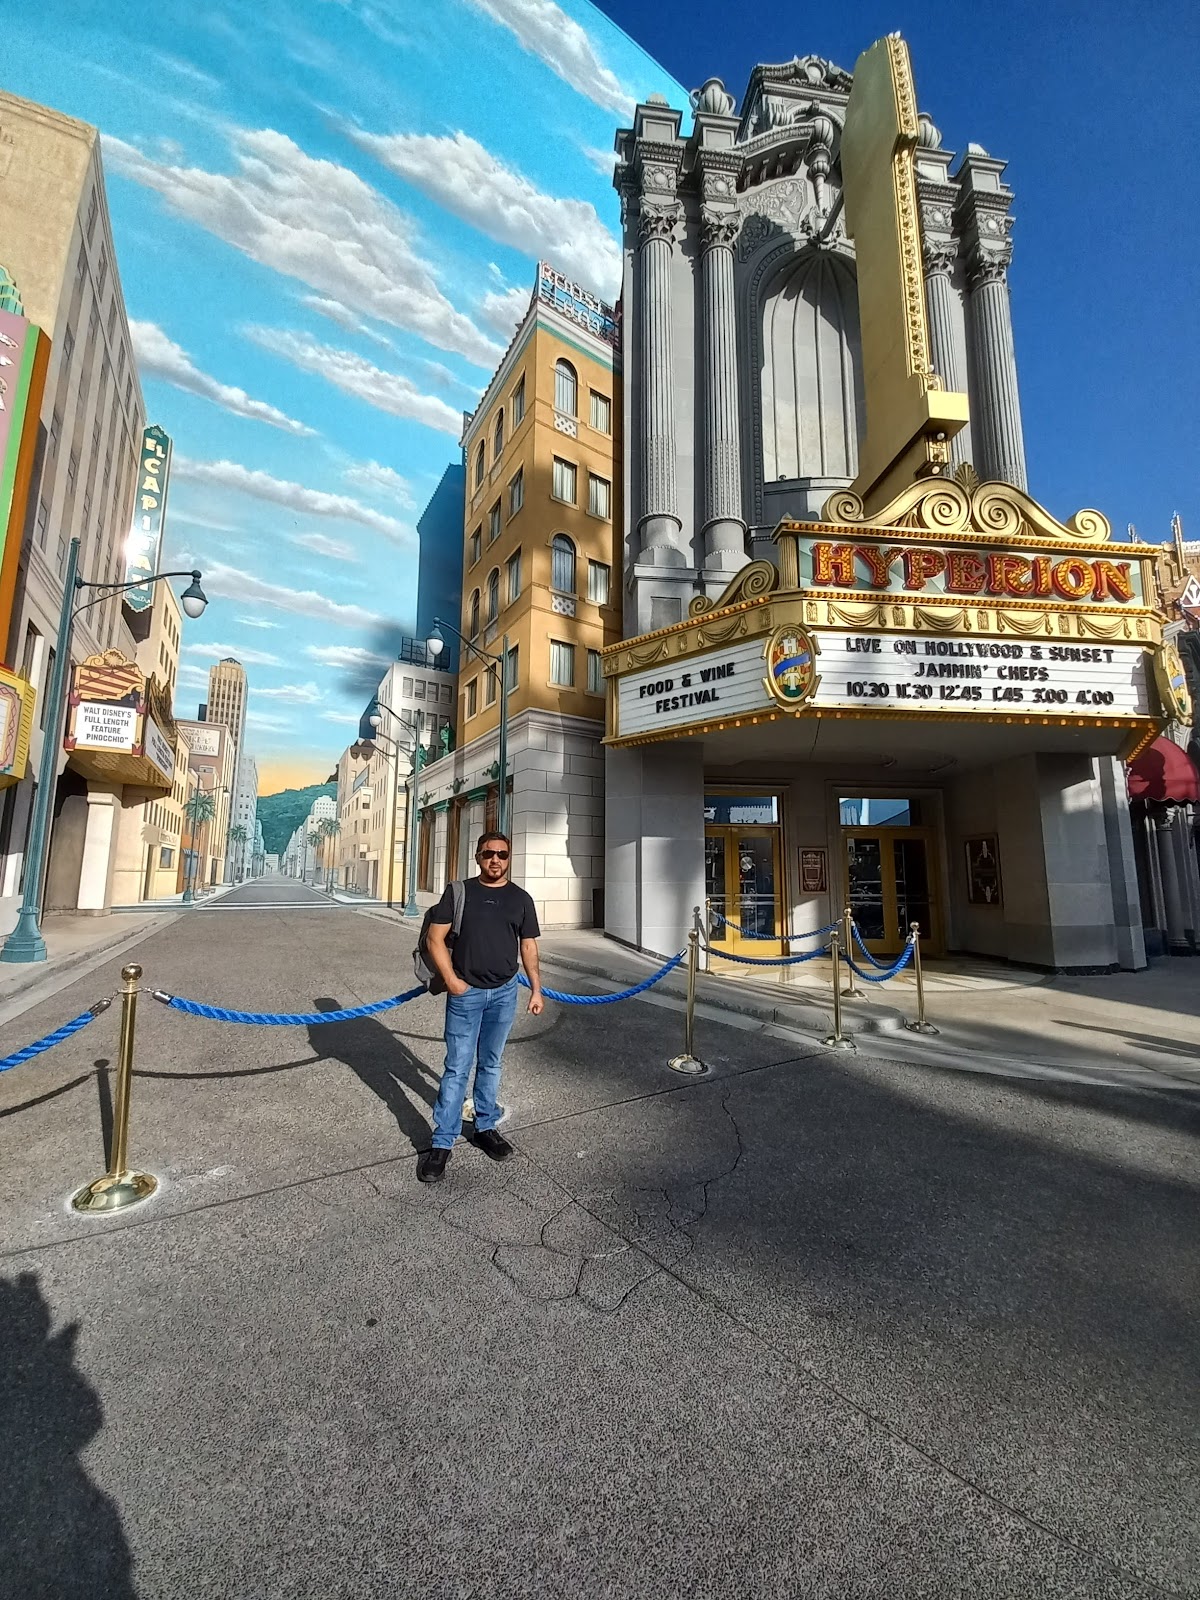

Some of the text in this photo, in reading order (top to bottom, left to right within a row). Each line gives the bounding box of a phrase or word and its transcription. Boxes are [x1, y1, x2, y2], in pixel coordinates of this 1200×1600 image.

[145, 437, 166, 459] EL
[811, 542, 1136, 603] HYPERION
[846, 638, 1114, 663] LIVE ON HOLLYWOOD & SUNSET
[639, 662, 735, 698] FOOD & WINE
[914, 662, 1050, 682] JAMMIN' CHEFS
[656, 688, 720, 713] FESTIVAL
[846, 681, 890, 698] 10:30
[896, 683, 933, 699] 11:30
[939, 684, 982, 701] 12:45
[1031, 688, 1068, 704] 3:00
[1075, 690, 1114, 706] 4:00
[84, 706, 132, 718] WALT DISNEY'S
[84, 716, 129, 727] FULL LENGTH
[91, 725, 121, 734] FEATURE
